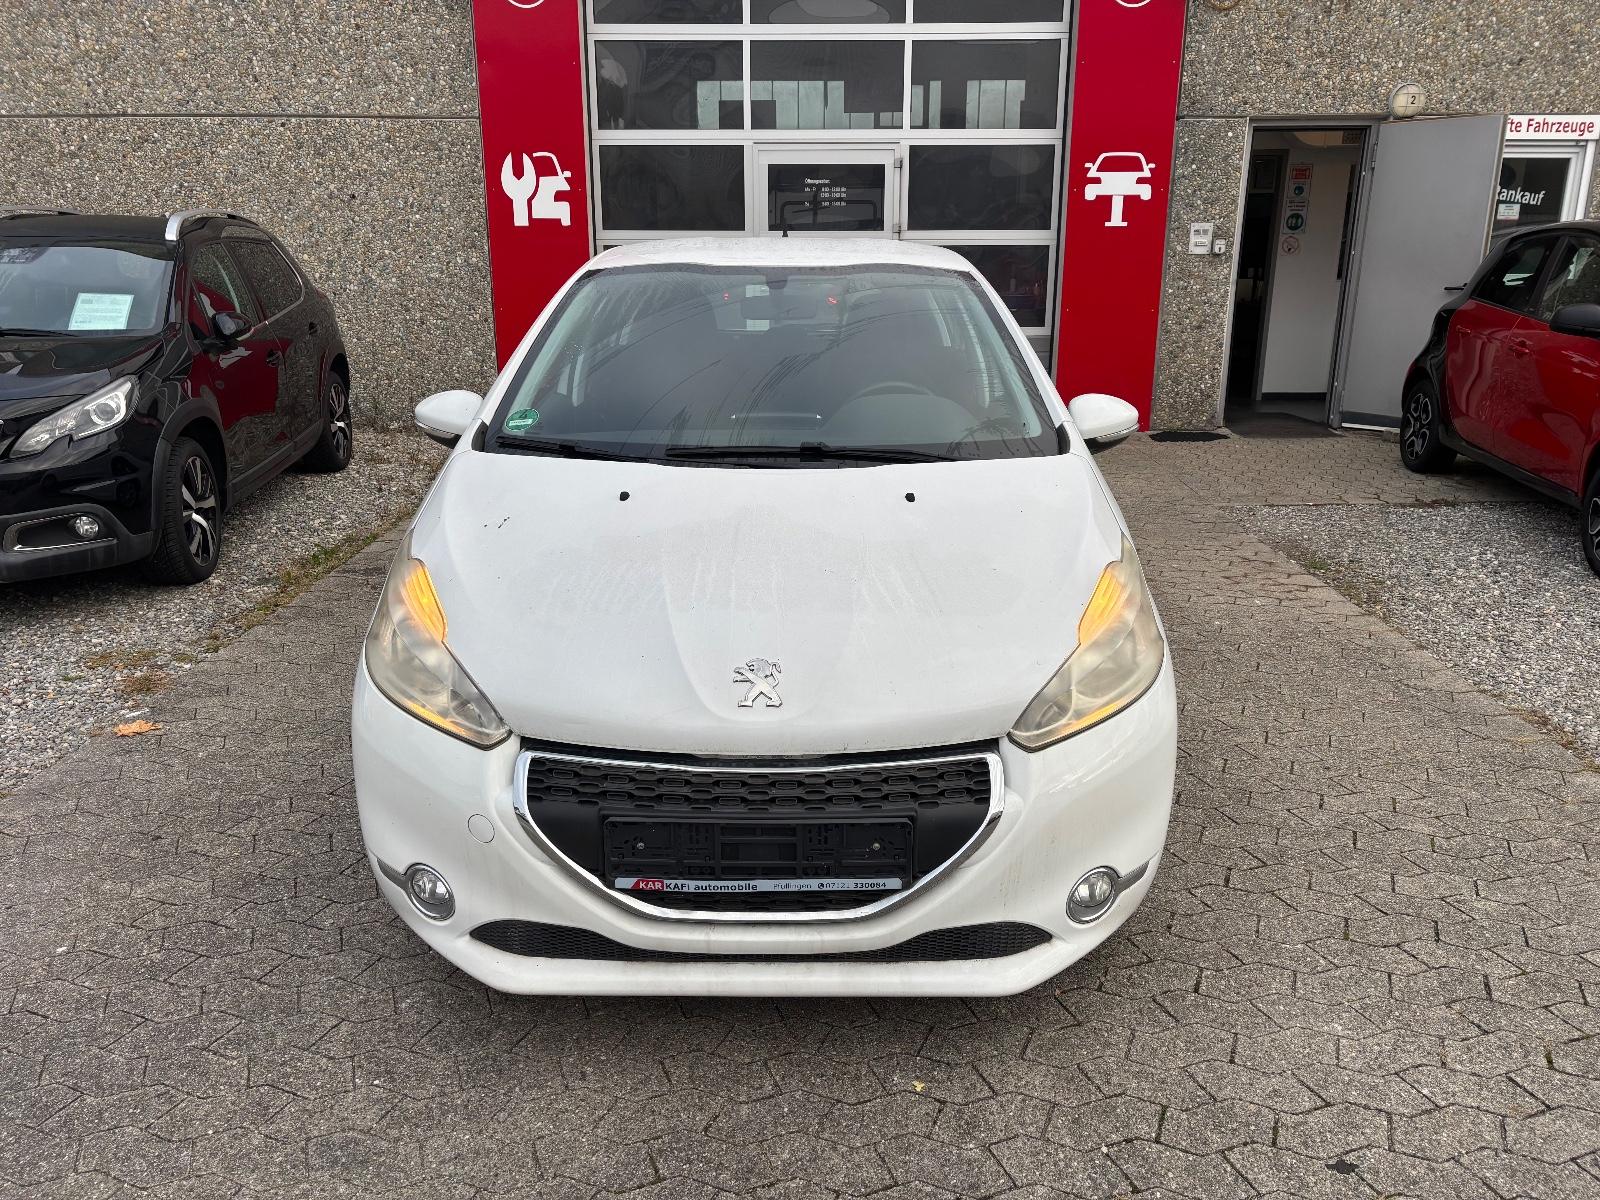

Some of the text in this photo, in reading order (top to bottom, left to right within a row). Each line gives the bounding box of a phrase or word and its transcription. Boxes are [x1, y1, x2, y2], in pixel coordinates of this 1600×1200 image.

[1410, 95, 1417, 105] 2
[1526, 118, 1595, 137] Fahrzeuge
[693, 883, 758, 891] automobile
